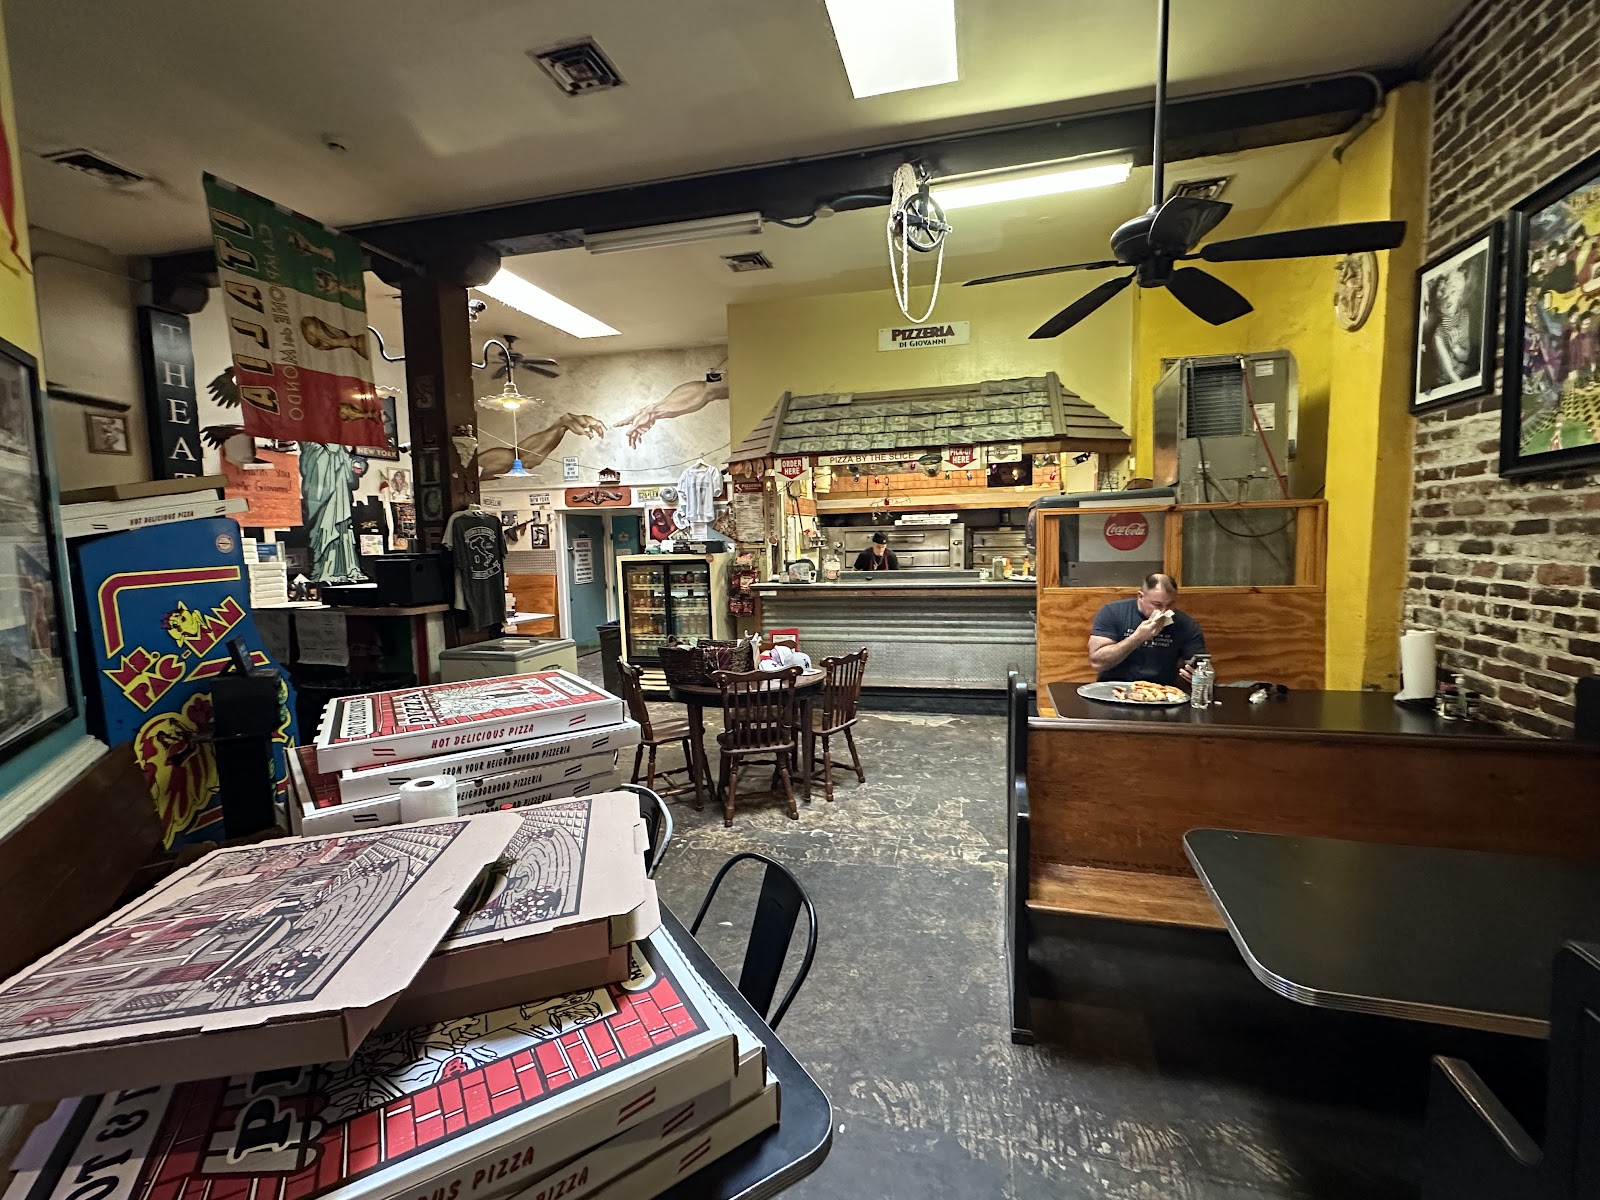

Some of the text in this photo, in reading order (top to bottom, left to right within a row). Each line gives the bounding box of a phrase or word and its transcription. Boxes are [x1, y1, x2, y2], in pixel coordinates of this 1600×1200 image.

[891, 325, 955, 341] PIZZERIA
[909, 338, 946, 347] GIOVANNI
[159, 322, 198, 479] THEA
[357, 446, 397, 458] NEW YORK
[829, 452, 914, 464] PIZZA BY THE SLICE
[950, 447, 972, 456] PICK-UP
[781, 459, 802, 468] ORDER
[952, 456, 970, 464] HERE
[784, 467, 800, 475] HERE
[129, 510, 194, 526] HOT DELICIOUS PIZZA
[1105, 522, 1147, 536] Coca-Cola
[402, 693, 431, 724] PIZZA
[431, 723, 535, 749] HOT DELICIOUS PIZZA
[442, 745, 571, 775] FROM YOUR NEIGHBORHOOD PIZZERIA
[512, 774, 543, 789] PIZZERIA
[472, 1146, 535, 1190] PIZZA
